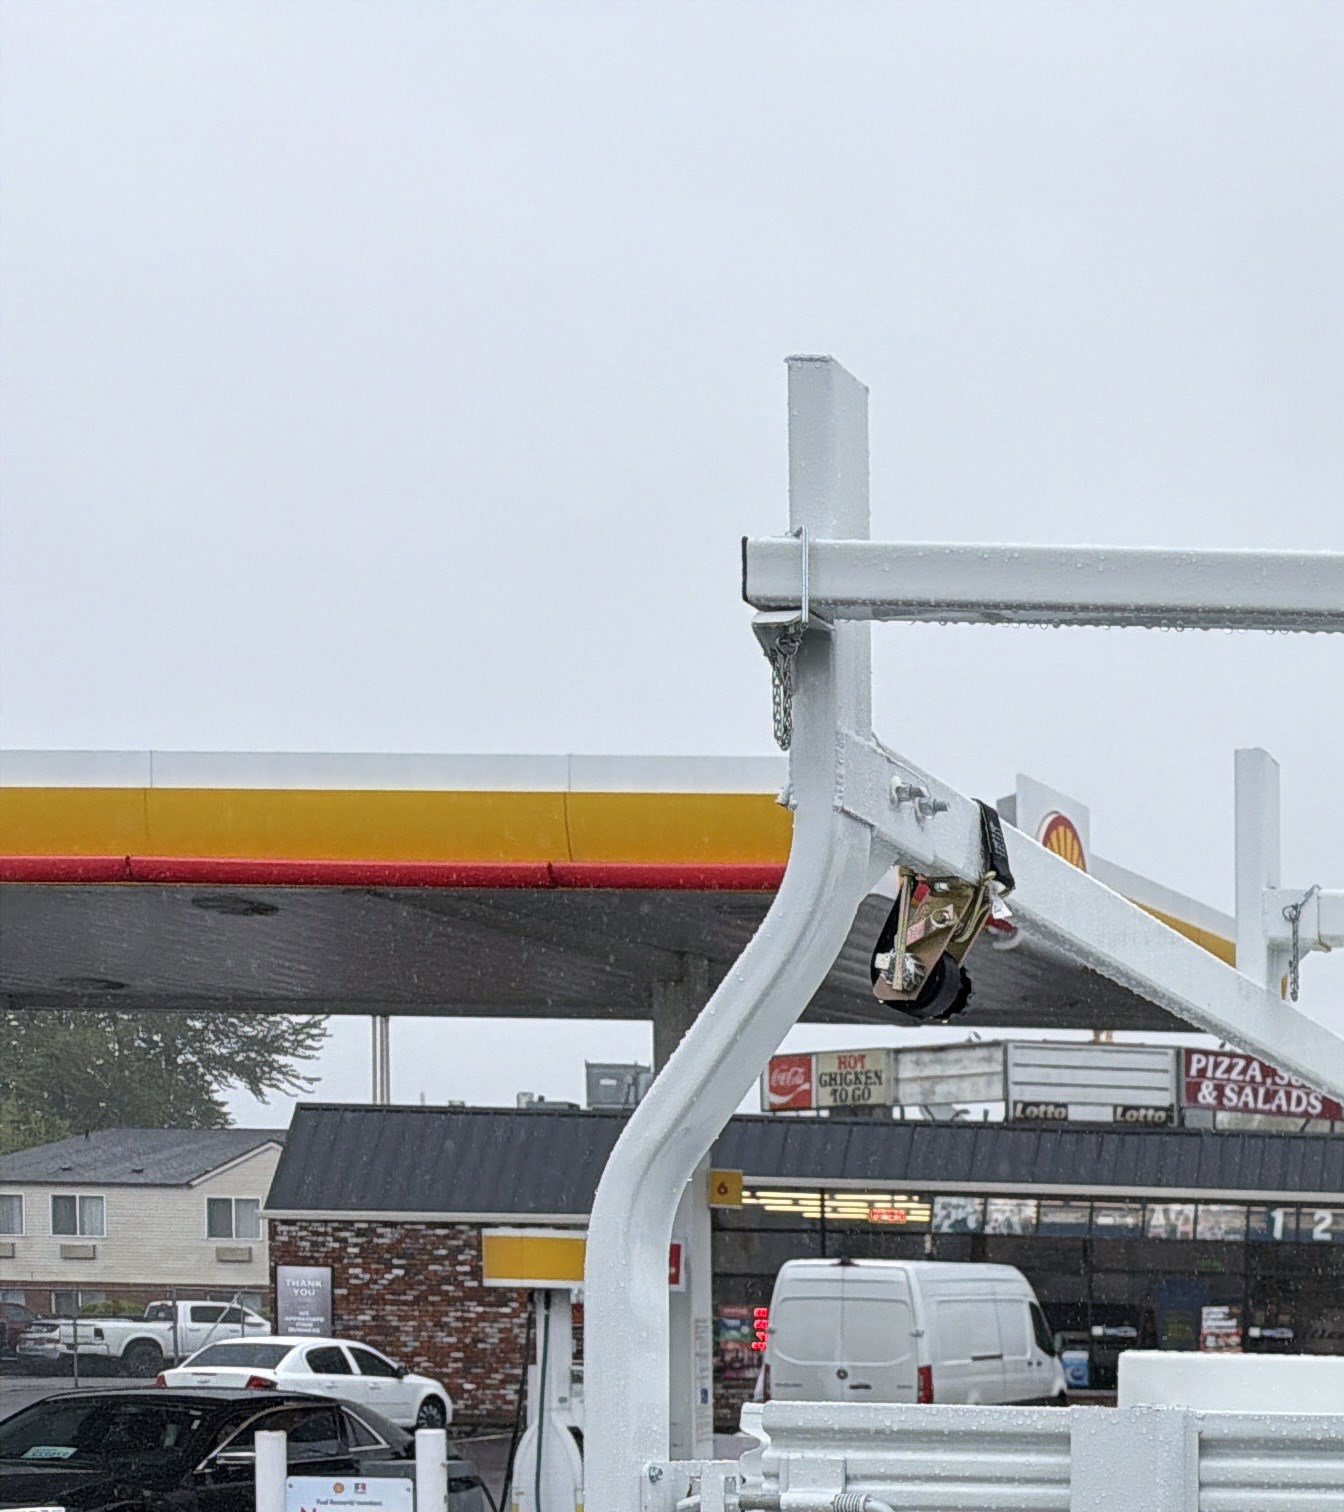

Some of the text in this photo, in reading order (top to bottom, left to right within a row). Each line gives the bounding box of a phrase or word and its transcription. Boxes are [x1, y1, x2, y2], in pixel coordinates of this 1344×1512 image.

[837, 1054, 867, 1070] HOT
[819, 1070, 883, 1088] CHICKEN
[830, 1087, 872, 1104] TO GO
[1197, 1080, 1323, 1115] & SALADS
[1014, 1102, 1067, 1120] Lotto
[1115, 1106, 1168, 1123] Lotto
[716, 1182, 728, 1196] 6
[286, 1279, 323, 1289] THANK
[293, 1288, 316, 1296] YOU
